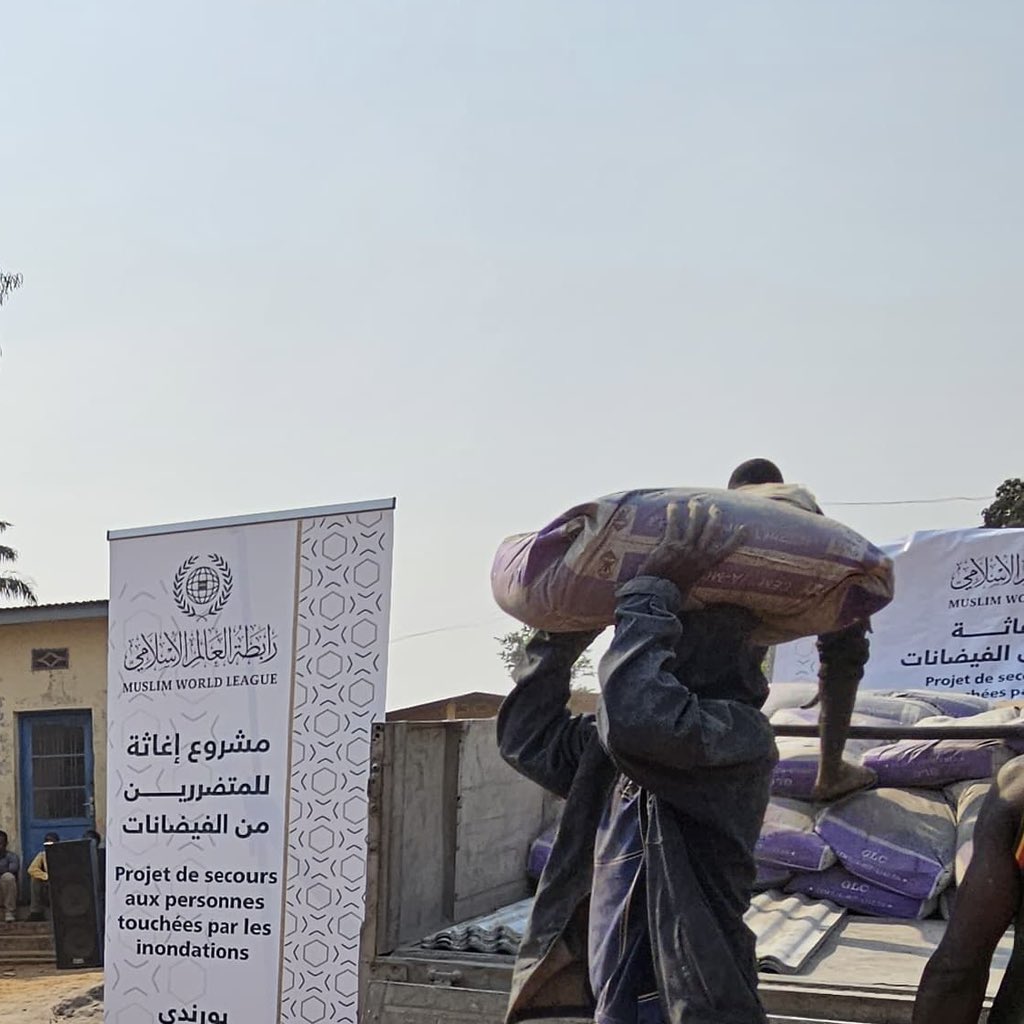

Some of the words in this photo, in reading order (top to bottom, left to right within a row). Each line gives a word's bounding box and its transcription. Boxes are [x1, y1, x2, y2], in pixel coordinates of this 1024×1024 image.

[948, 596, 1001, 609] MUSLIM
[901, 644, 1010, 668] الفيضانات
[122, 679, 172, 693] MUSLIM
[176, 676, 223, 690] WORLD
[226, 673, 278, 687] LEAGUE
[925, 675, 970, 688] Projet
[975, 673, 993, 684] de
[127, 732, 180, 764] إغاثة
[187, 729, 270, 763] مشروع
[122, 813, 228, 840] الفيضانات
[235, 819, 269, 838] من
[115, 866, 171, 886] Projet
[176, 866, 199, 882] de
[204, 870, 278, 884] secours
[125, 893, 160, 907] aux
[166, 894, 265, 911] personnes
[118, 915, 203, 933] touchées
[207, 919, 238, 937] par
[244, 917, 271, 936] les
[136, 939, 249, 960] inondations
